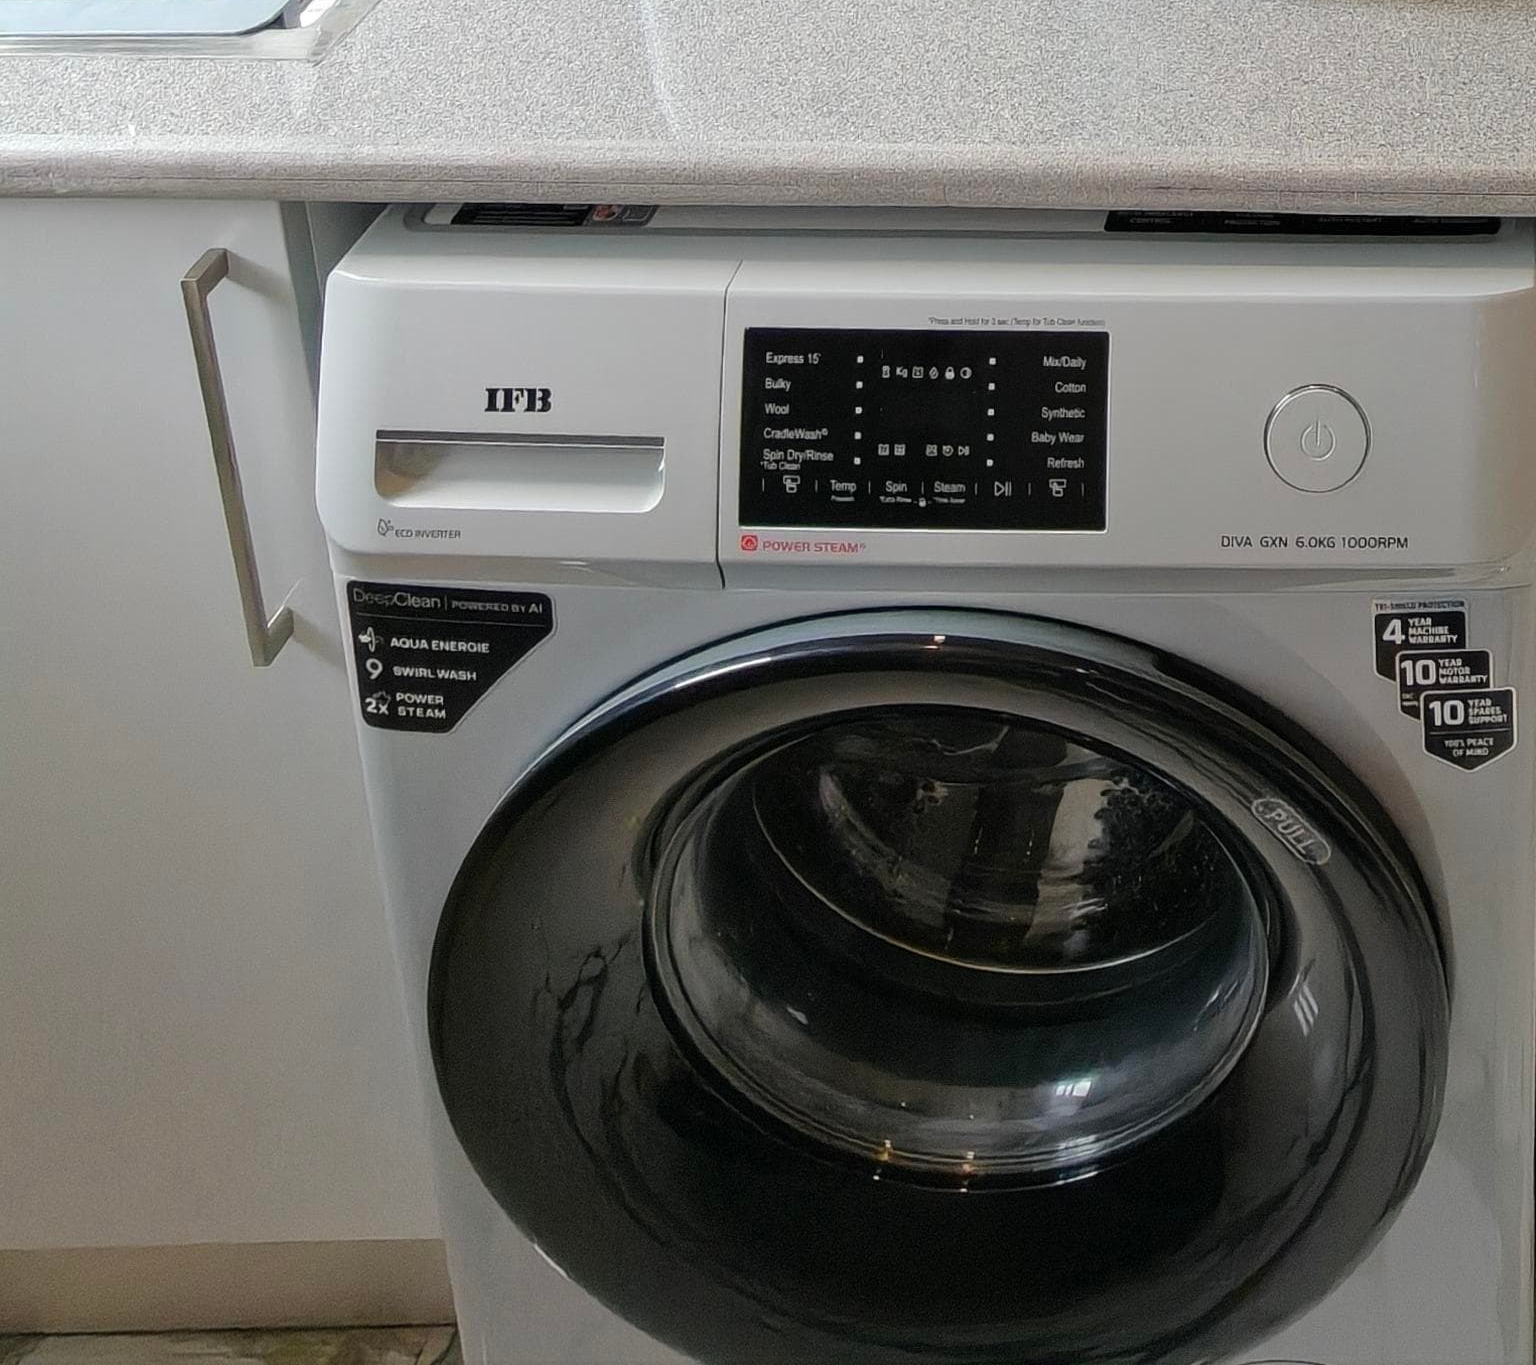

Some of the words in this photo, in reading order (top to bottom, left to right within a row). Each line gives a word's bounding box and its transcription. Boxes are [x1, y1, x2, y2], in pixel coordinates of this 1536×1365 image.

[766, 352, 804, 365] Express
[1043, 356, 1087, 370] Mix/Daily
[896, 366, 908, 378] Kg
[765, 377, 791, 392] Bulky
[1055, 381, 1086, 393] Cotton
[484, 388, 552, 412] IFB
[765, 403, 790, 414] Wool
[1041, 407, 1086, 421] Synthetic
[1031, 431, 1056, 445] Baby
[1058, 431, 1085, 443] Wear
[763, 448, 784, 461] Spin
[787, 449, 834, 462] Dry/Rinse
[1047, 457, 1085, 469] Refresh
[830, 479, 857, 492] Temp
[885, 481, 907, 494] Spin
[934, 481, 966, 493] Steam
[395, 529, 413, 538] ECO
[415, 530, 461, 539] INVERTER
[763, 541, 810, 552] POWER
[1221, 535, 1253, 548] DIVA
[1259, 536, 1288, 548] GXN
[1295, 536, 1336, 549] 6.0KG
[1342, 537, 1408, 549] 1000RPM
[353, 588, 441, 609] DeepClean
[452, 600, 509, 612] POWERED
[512, 604, 527, 613] BY
[528, 603, 543, 613] AI
[1408, 617, 1432, 626] YEAR
[1382, 619, 1406, 645] 4
[1408, 626, 1449, 635] MACHINE
[390, 638, 429, 649] AQUA
[431, 640, 490, 653] ENERGIE
[1408, 635, 1458, 644] WARRANTY
[1438, 658, 1462, 667] YEAR
[365, 658, 383, 679] 9
[393, 666, 436, 678] SWIRL
[437, 670, 477, 681] WASH
[1401, 659, 1436, 686] 10
[1439, 666, 1470, 675] MOTOR
[1439, 675, 1488, 684] WARRANTY
[396, 692, 444, 706] POWER
[1467, 698, 1492, 707] YEAR
[398, 706, 446, 719] STEAM
[1429, 700, 1465, 726] 10
[1468, 706, 1502, 715] SPARES
[1468, 714, 1507, 724] SUPPORT
[1466, 737, 1494, 746] PEACE
[1452, 749, 1463, 757] OF
[1466, 748, 1489, 756] MIND
[1264, 808, 1317, 855] PULL
